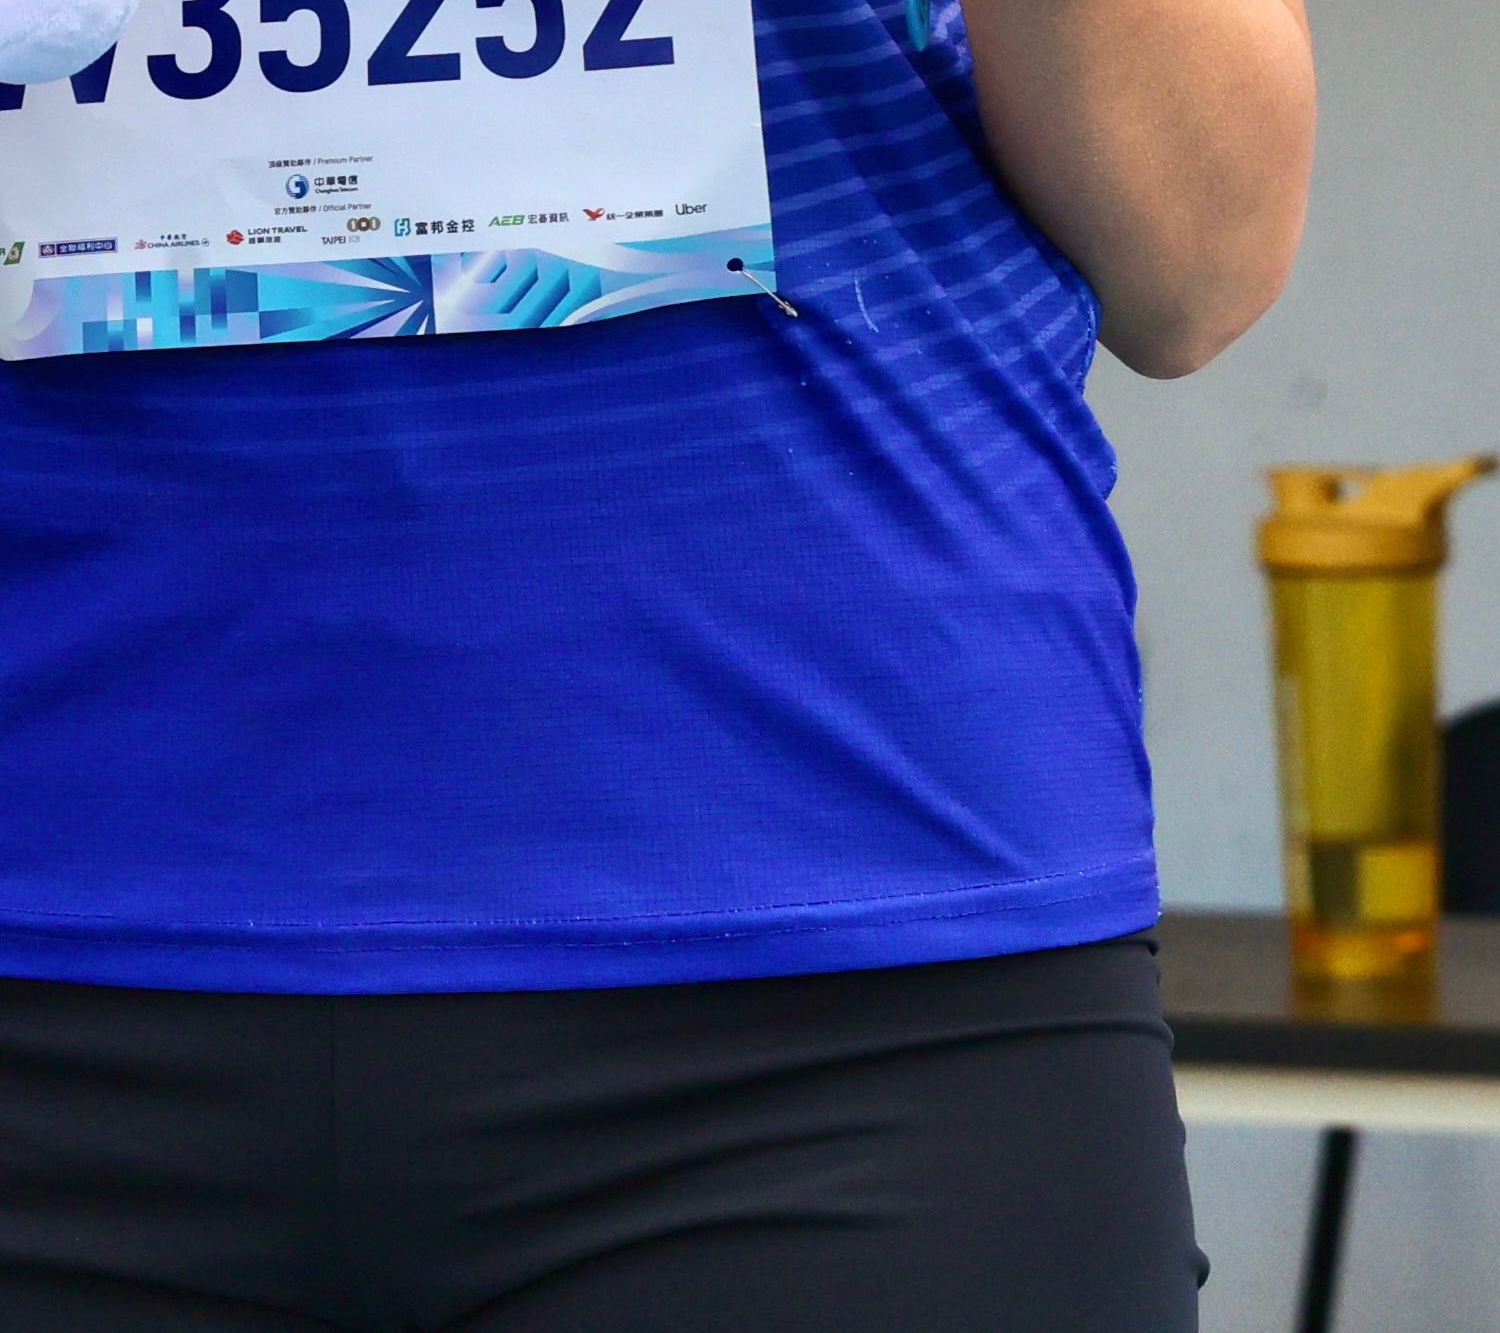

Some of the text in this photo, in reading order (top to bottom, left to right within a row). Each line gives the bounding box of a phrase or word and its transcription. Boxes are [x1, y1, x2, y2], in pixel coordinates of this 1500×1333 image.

[317, 157, 348, 165] Premium
[322, 204, 347, 212] Official
[347, 203, 372, 211] Partner
[675, 203, 707, 216] Uber
[272, 226, 308, 234] TRAVEL
[415, 219, 475, 236] 富邦金控
[170, 239, 200, 247] AIRLINES
[321, 236, 346, 245] TAIPEI
